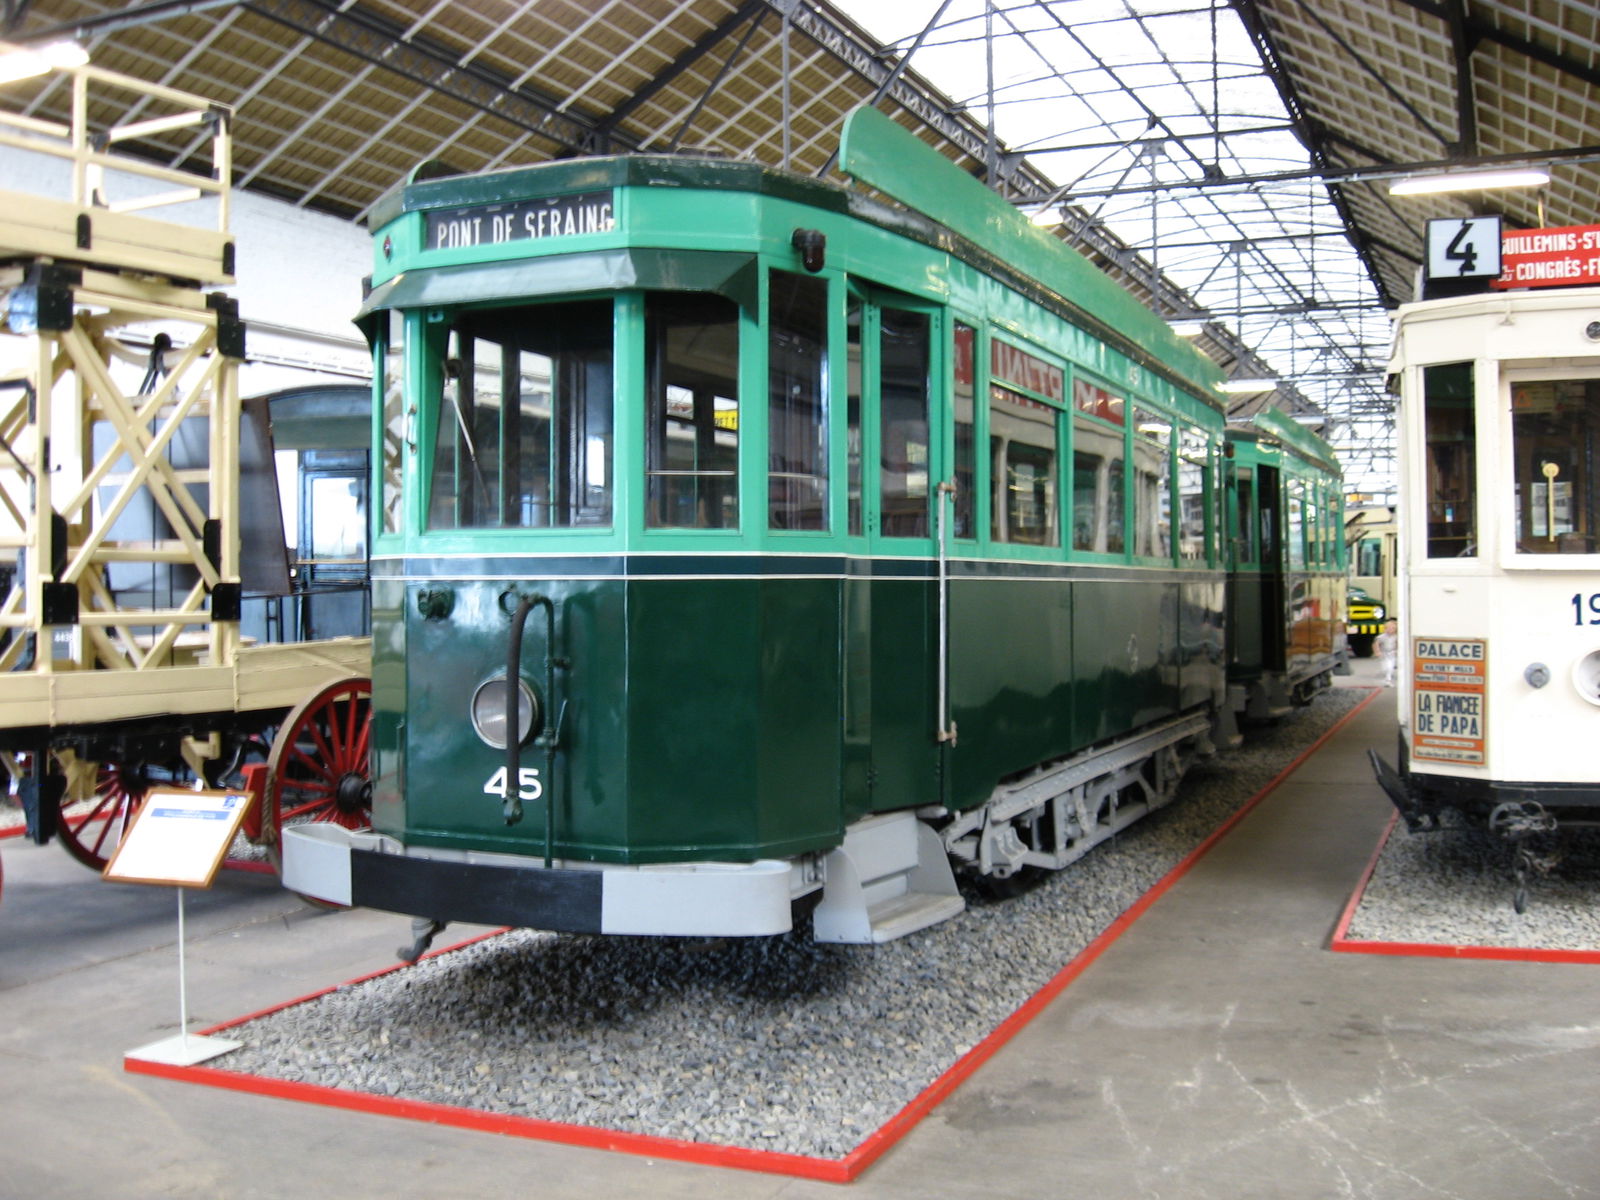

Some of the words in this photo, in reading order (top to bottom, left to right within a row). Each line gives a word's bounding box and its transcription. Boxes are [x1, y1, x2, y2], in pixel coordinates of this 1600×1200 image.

[437, 217, 482, 249] PONT
[493, 213, 515, 242] DE
[524, 203, 614, 239] SERAING
[1446, 222, 1478, 272] 4
[1516, 256, 1581, 280] CONGRÈS
[1418, 643, 1482, 658] PALACE
[1418, 693, 1431, 712] LA
[1418, 714, 1434, 732] DE
[1441, 714, 1478, 736] PAPA
[483, 766, 543, 800] 45
